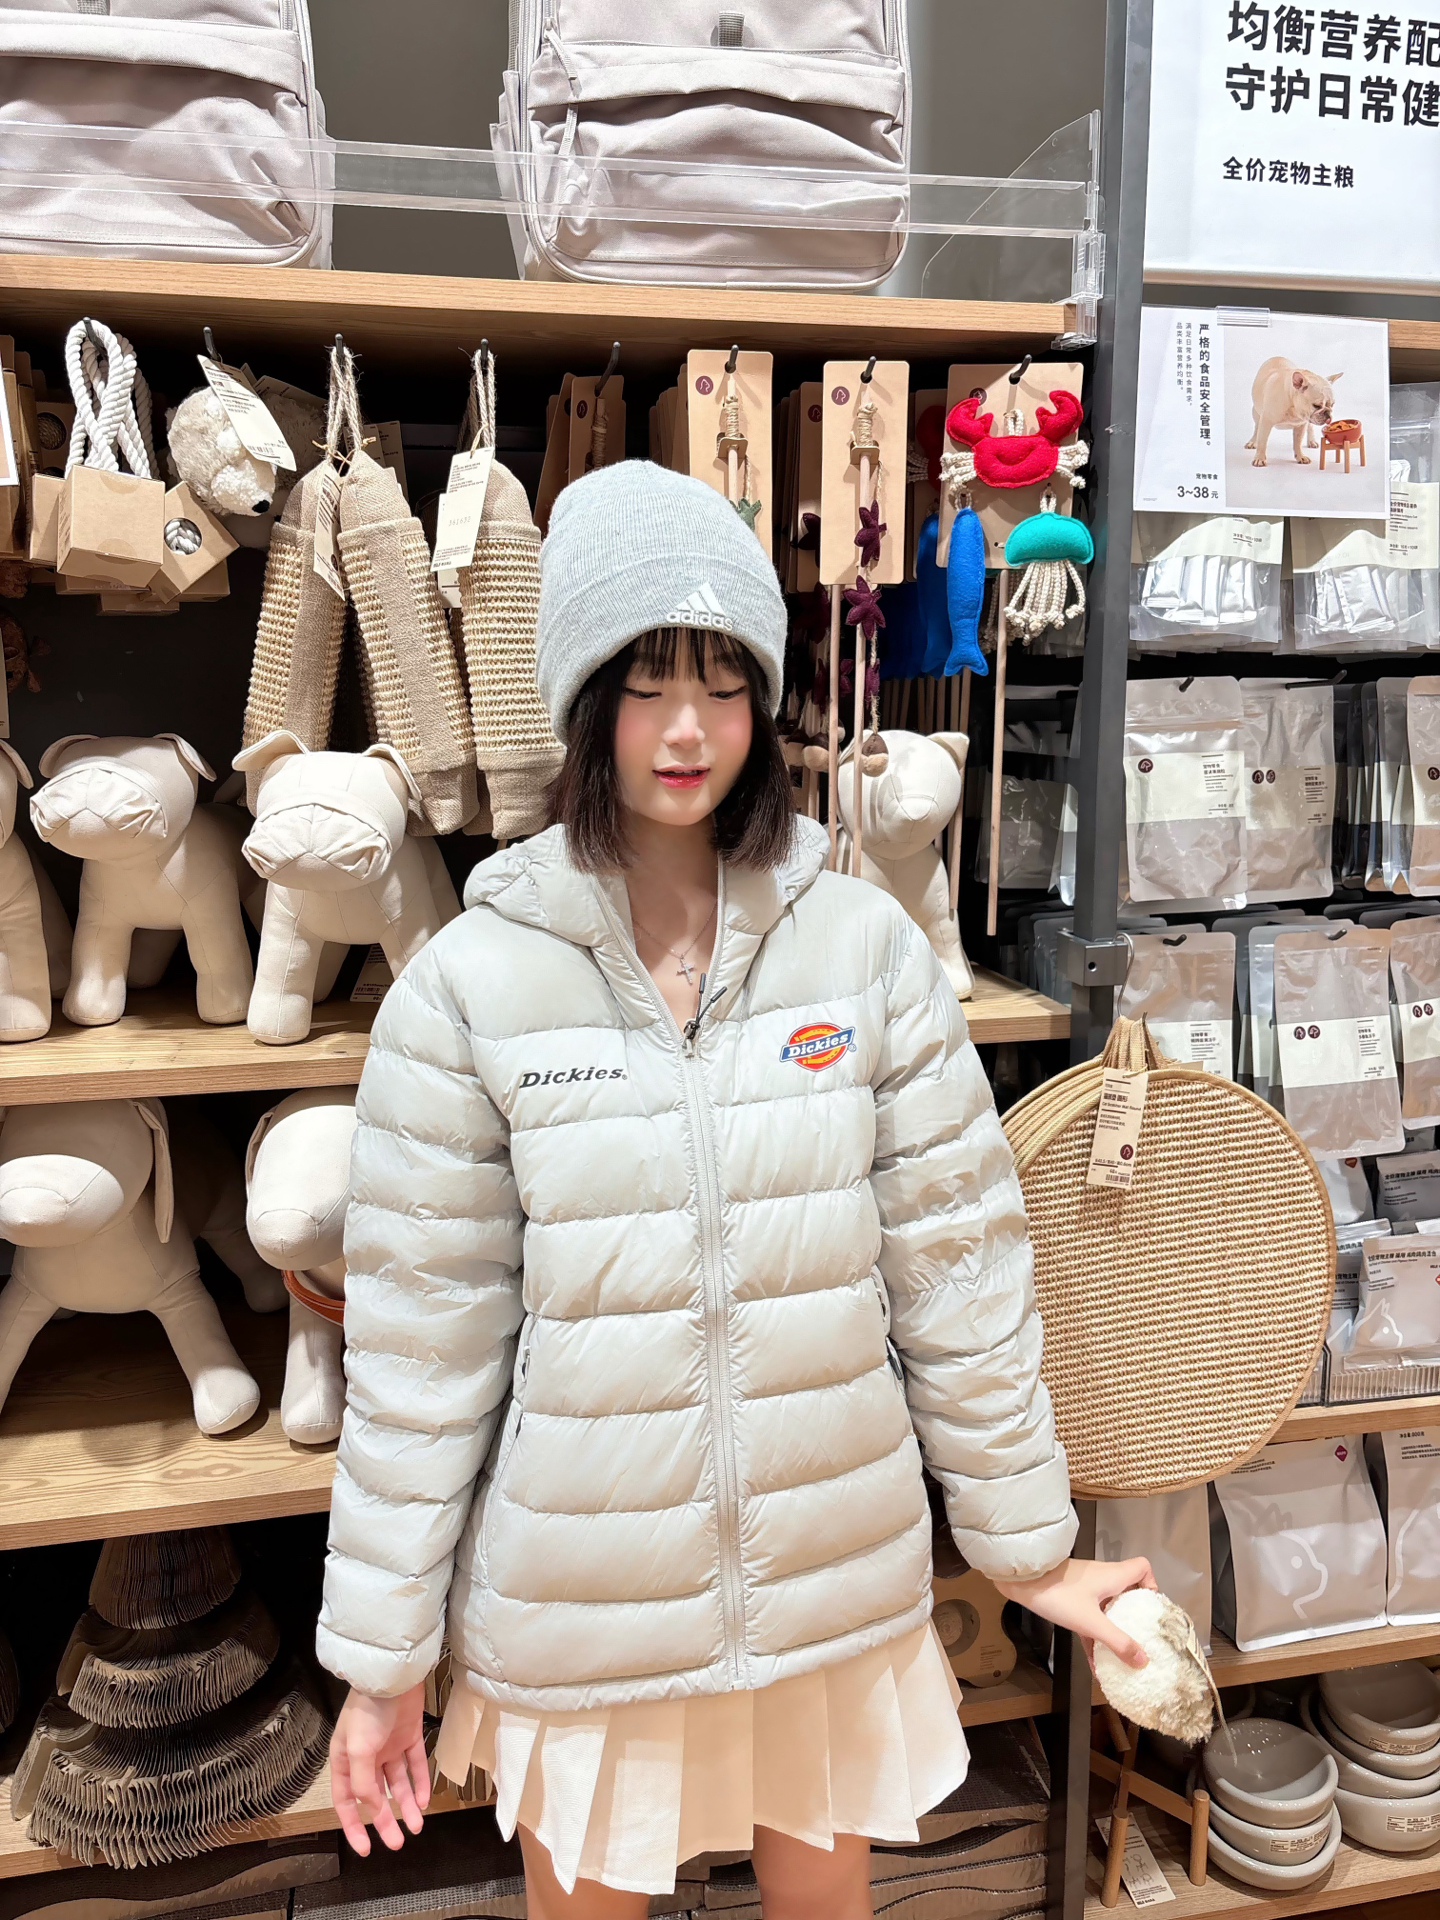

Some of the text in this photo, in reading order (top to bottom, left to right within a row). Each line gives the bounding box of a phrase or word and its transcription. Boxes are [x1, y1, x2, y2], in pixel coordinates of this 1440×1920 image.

[1227, 0, 1440, 68] 均衡营养配
[1225, 62, 1440, 127] 守护日常健
[1222, 155, 1354, 188] 全价宠物主粮
[1198, 323, 1211, 446] 严格的食品安全管理。
[666, 609, 733, 631] adidas
[788, 1033, 849, 1057] Dickies
[518, 1066, 624, 1089] Dickies
